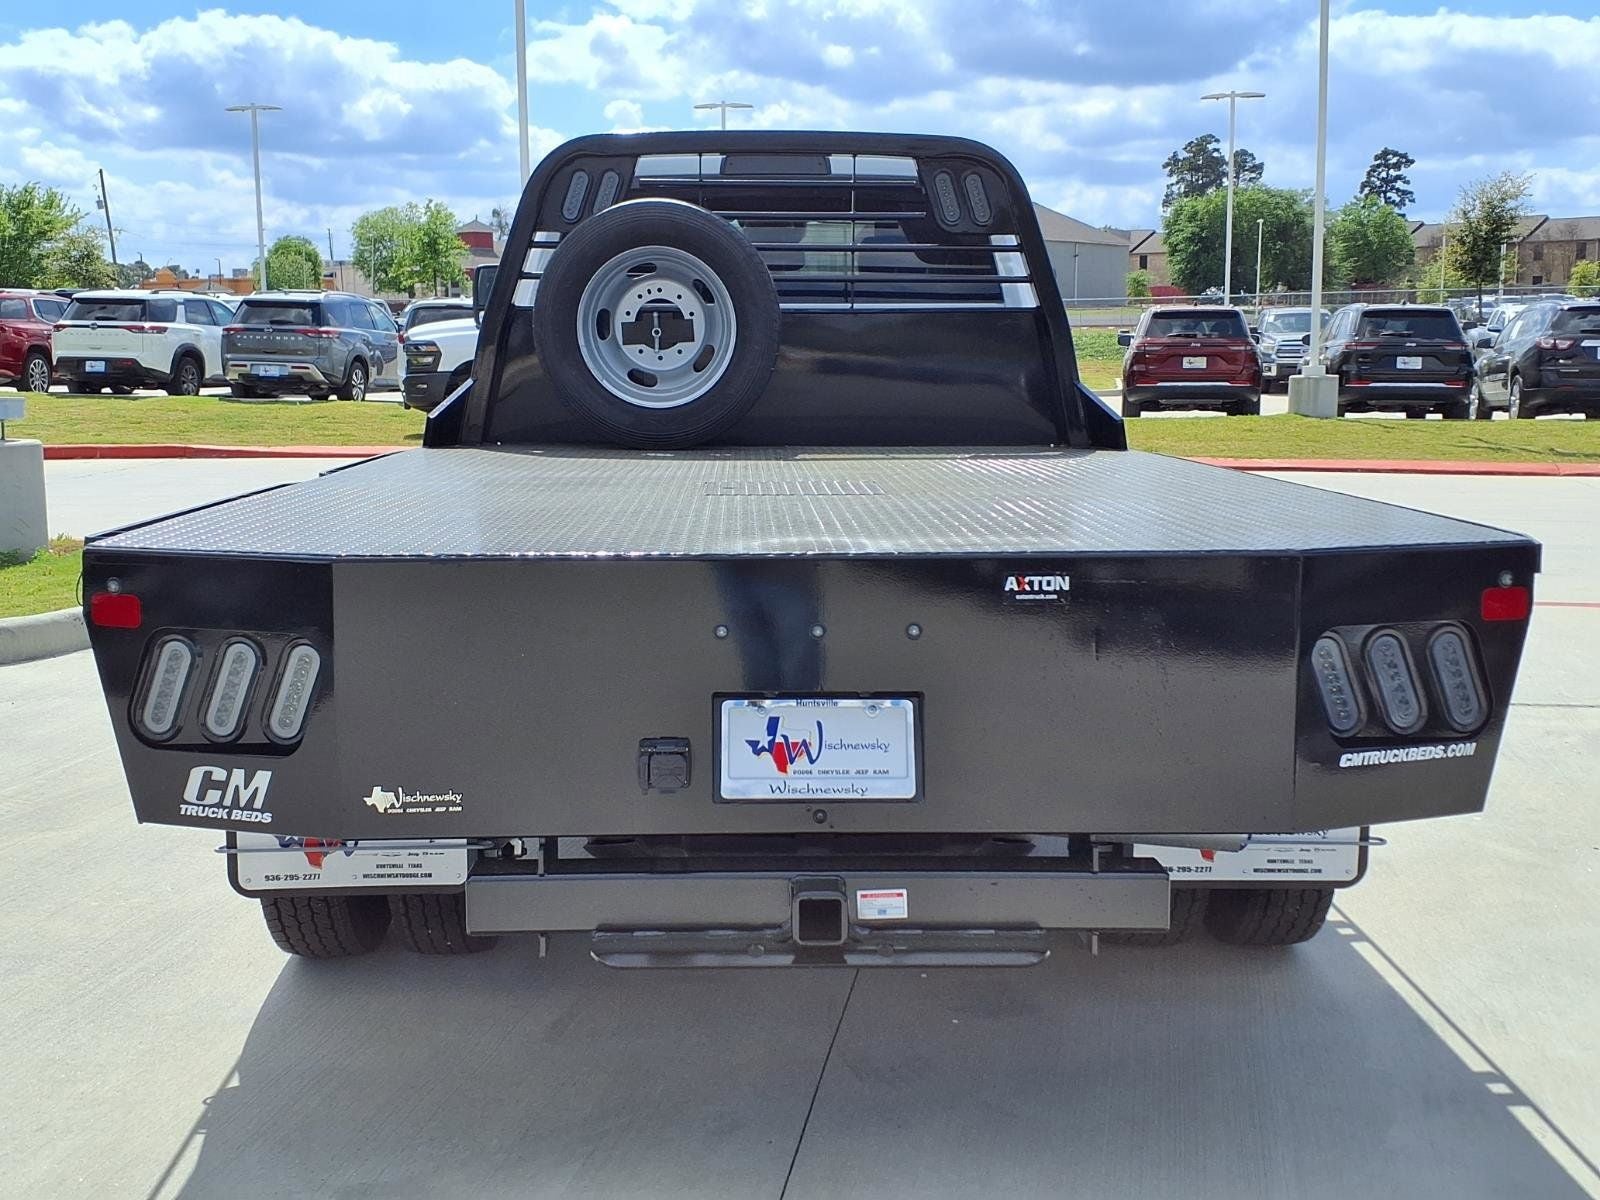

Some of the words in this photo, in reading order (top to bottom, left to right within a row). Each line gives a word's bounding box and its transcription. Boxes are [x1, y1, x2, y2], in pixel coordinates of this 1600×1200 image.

[1004, 575, 1070, 592] AXTON
[795, 698, 839, 708] Huntsville
[1338, 742, 1477, 769] CMTRUCKBEDS.COM
[182, 765, 274, 810] CM
[769, 779, 868, 797] Wischnewsky
[179, 804, 230, 820] TRUCK
[231, 809, 274, 824] BEDS
[264, 873, 321, 882] 936-295-2277
